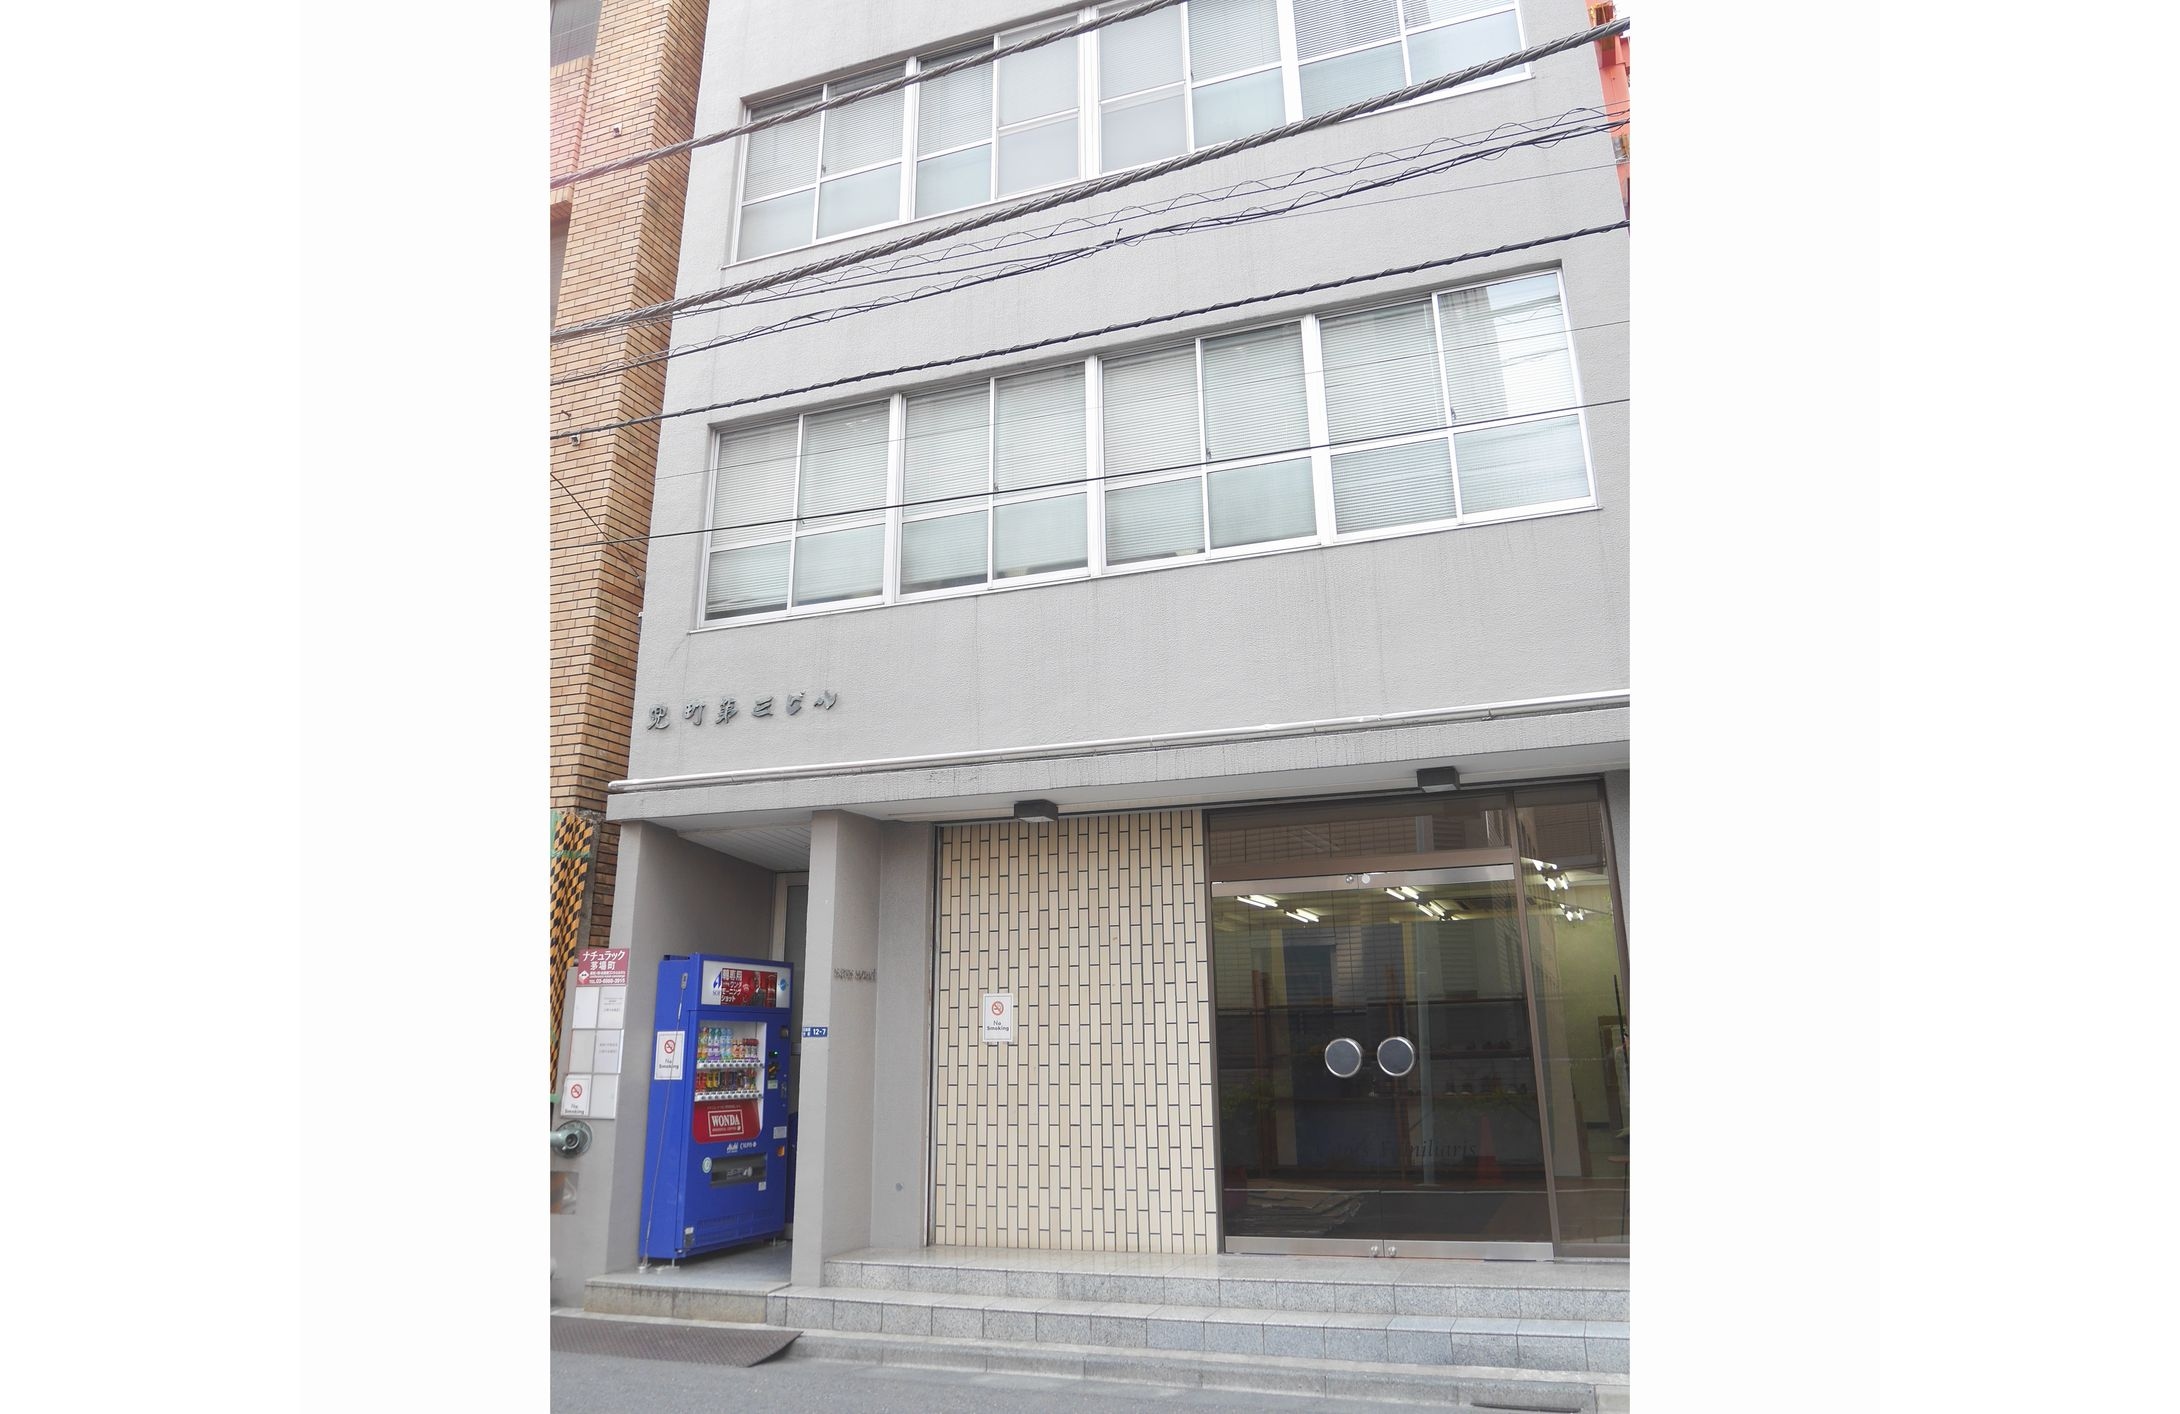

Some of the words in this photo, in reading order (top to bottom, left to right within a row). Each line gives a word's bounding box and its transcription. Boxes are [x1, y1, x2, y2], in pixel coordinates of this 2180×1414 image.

[582, 950, 626, 962] ナチュラック
[812, 1027, 827, 1036] 12-7
[711, 1114, 740, 1127] WONDA
